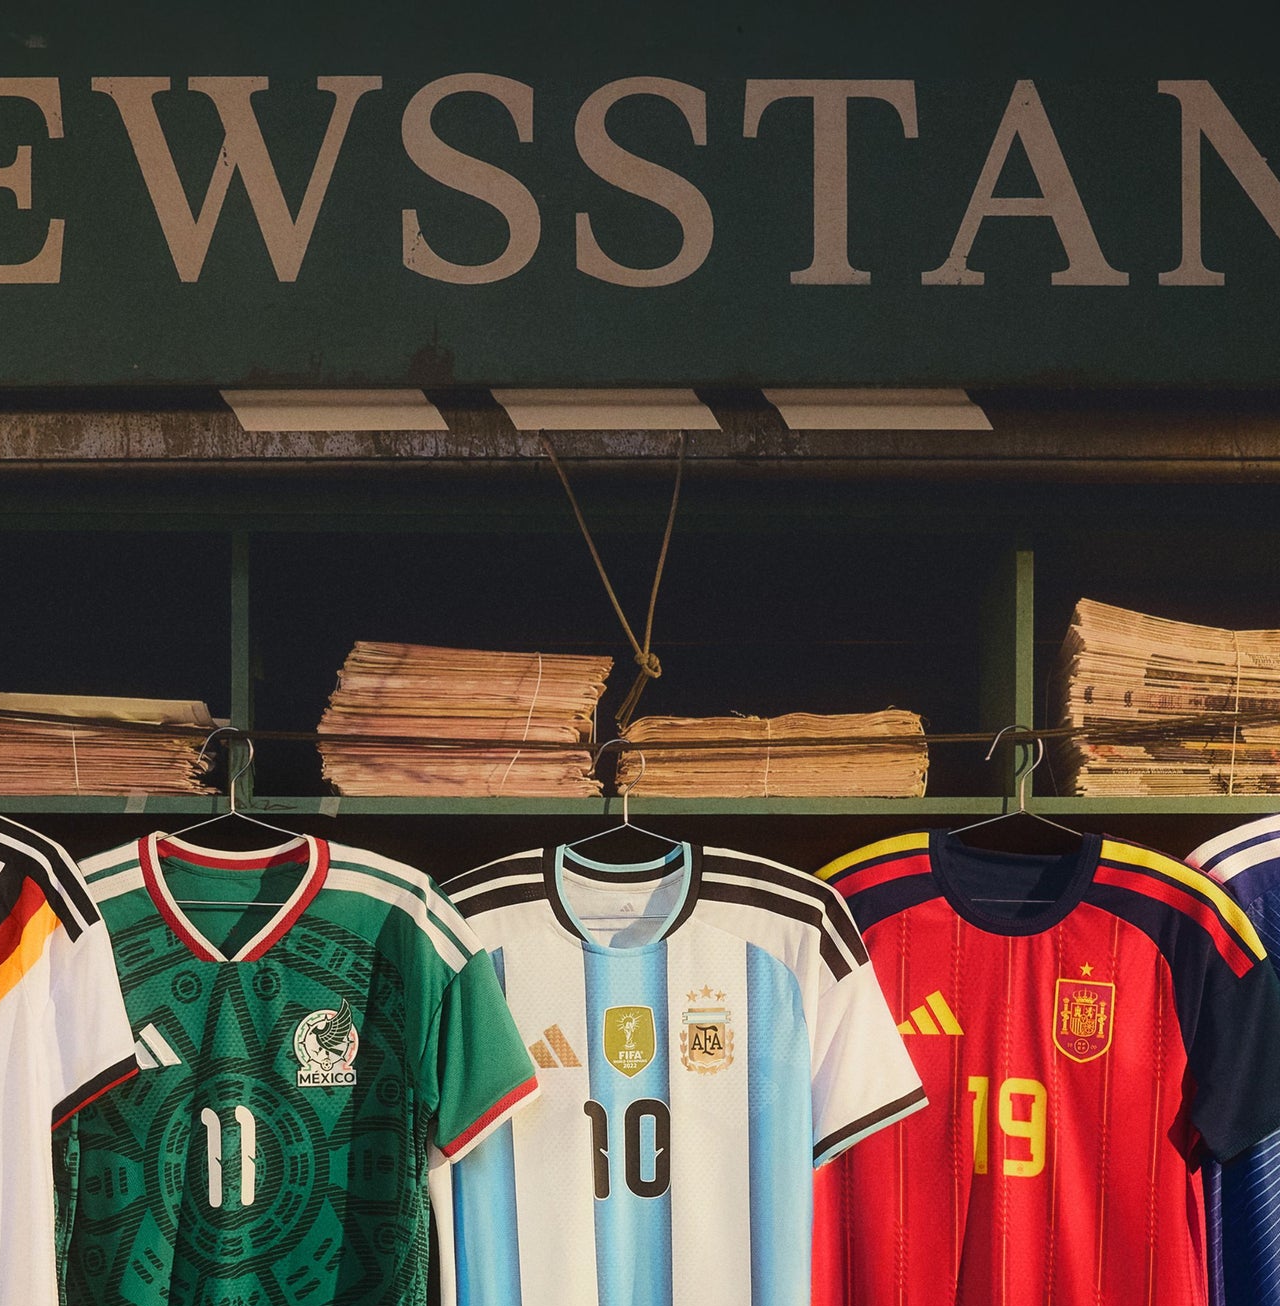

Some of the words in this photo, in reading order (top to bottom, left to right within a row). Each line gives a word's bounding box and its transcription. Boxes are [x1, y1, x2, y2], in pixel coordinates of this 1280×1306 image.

[299, 1070, 355, 1085] MÉXICO
[691, 1025, 723, 1055] AFA
[201, 1106, 256, 1208] 11
[583, 1098, 671, 1200] 10
[968, 1076, 1047, 1178] 19
